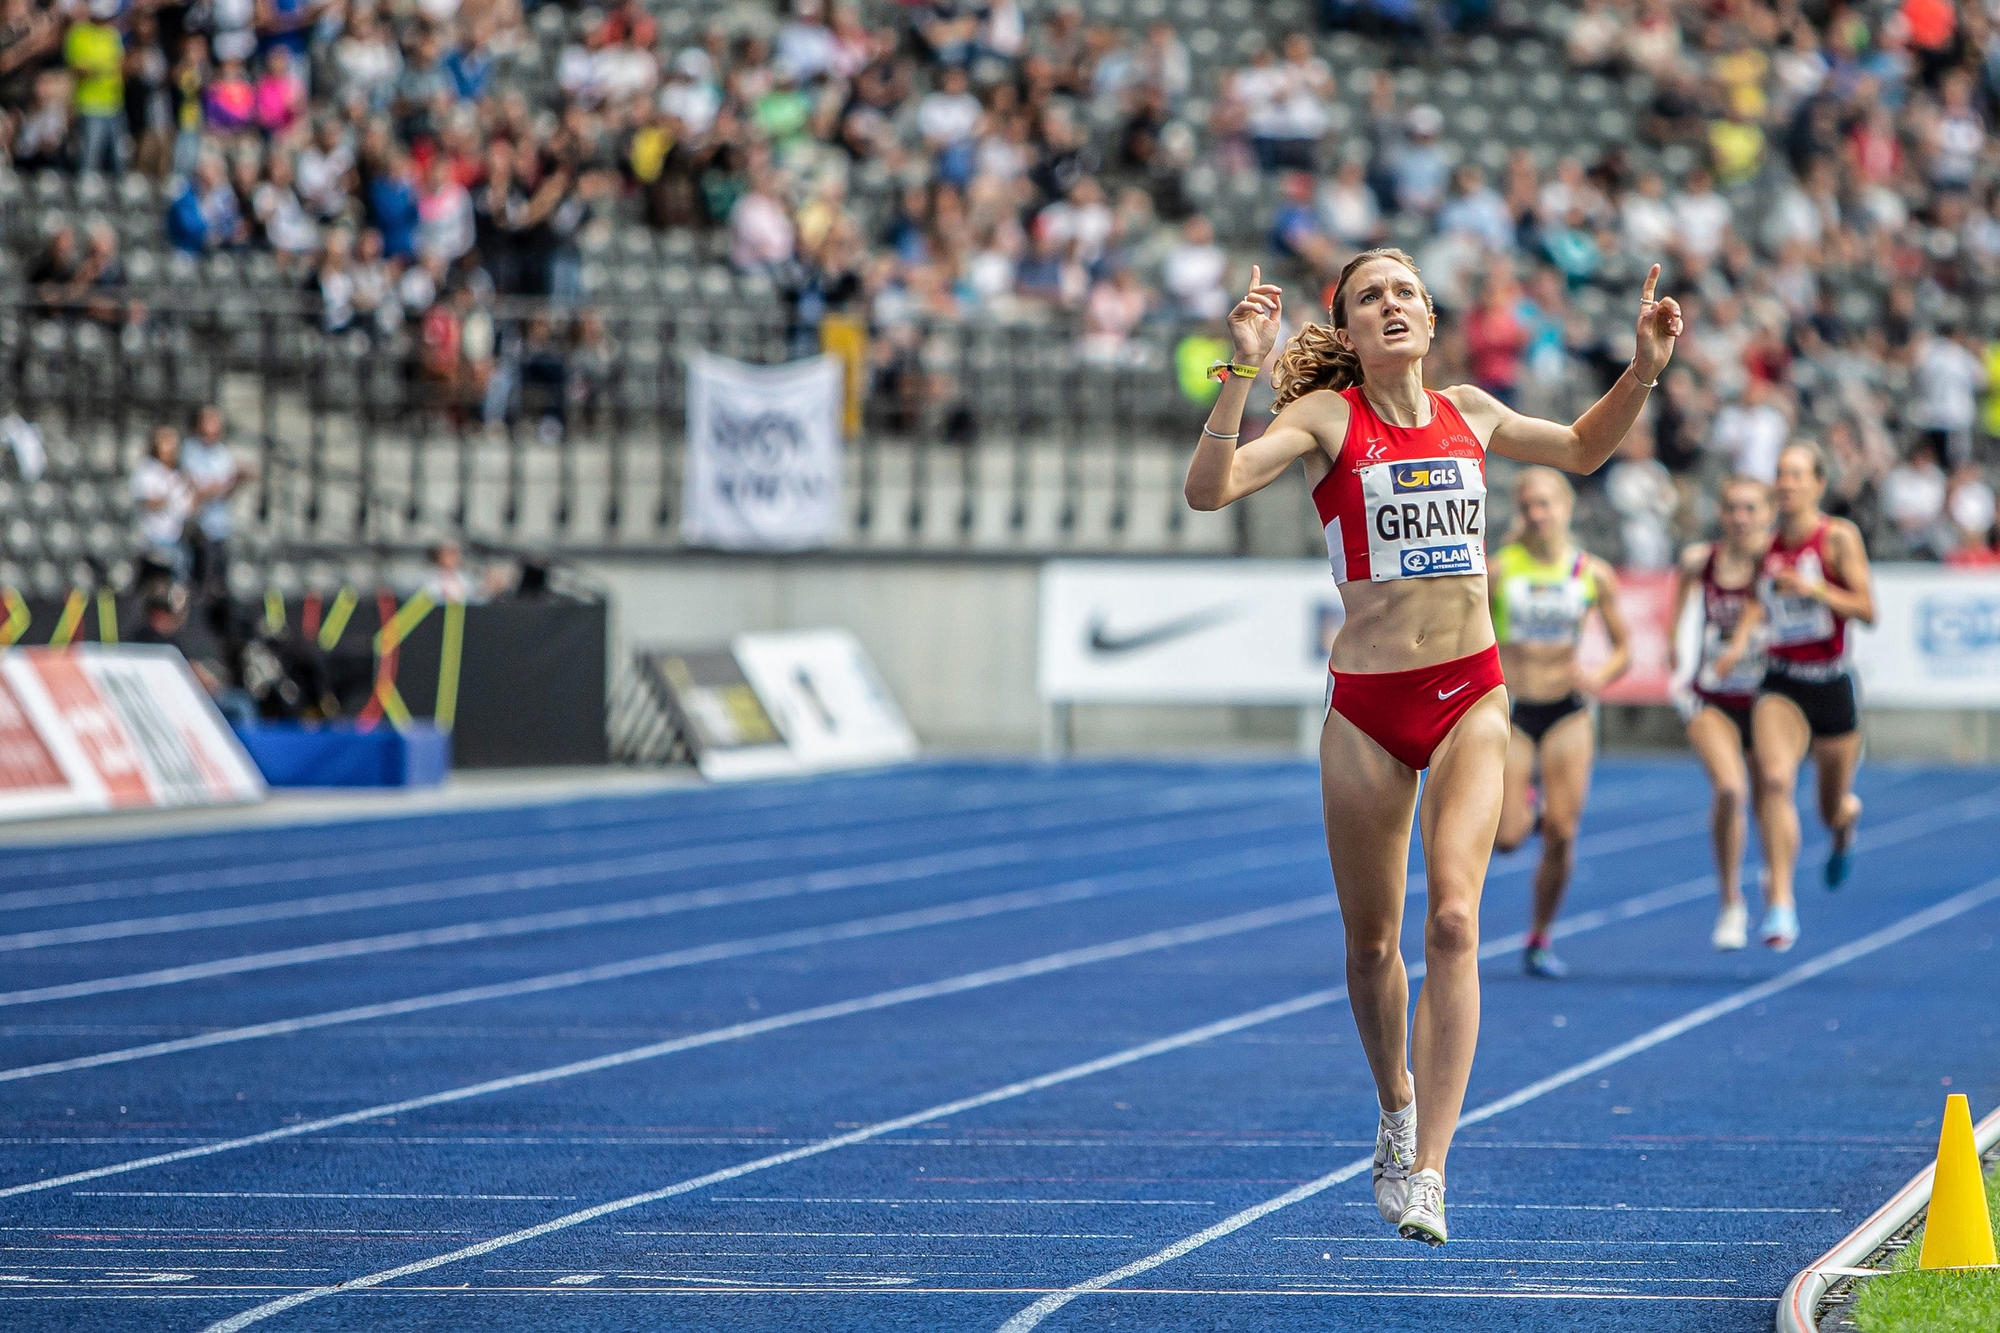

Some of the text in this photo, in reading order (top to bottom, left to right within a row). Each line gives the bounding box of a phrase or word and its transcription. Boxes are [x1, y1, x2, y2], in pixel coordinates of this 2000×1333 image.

[1437, 433, 1476, 450] LG NORD
[1448, 449, 1475, 457] BERLIN
[1429, 468, 1456, 485] GLS
[1375, 499, 1480, 541] GRANZ
[1432, 549, 1470, 564] PLAN
